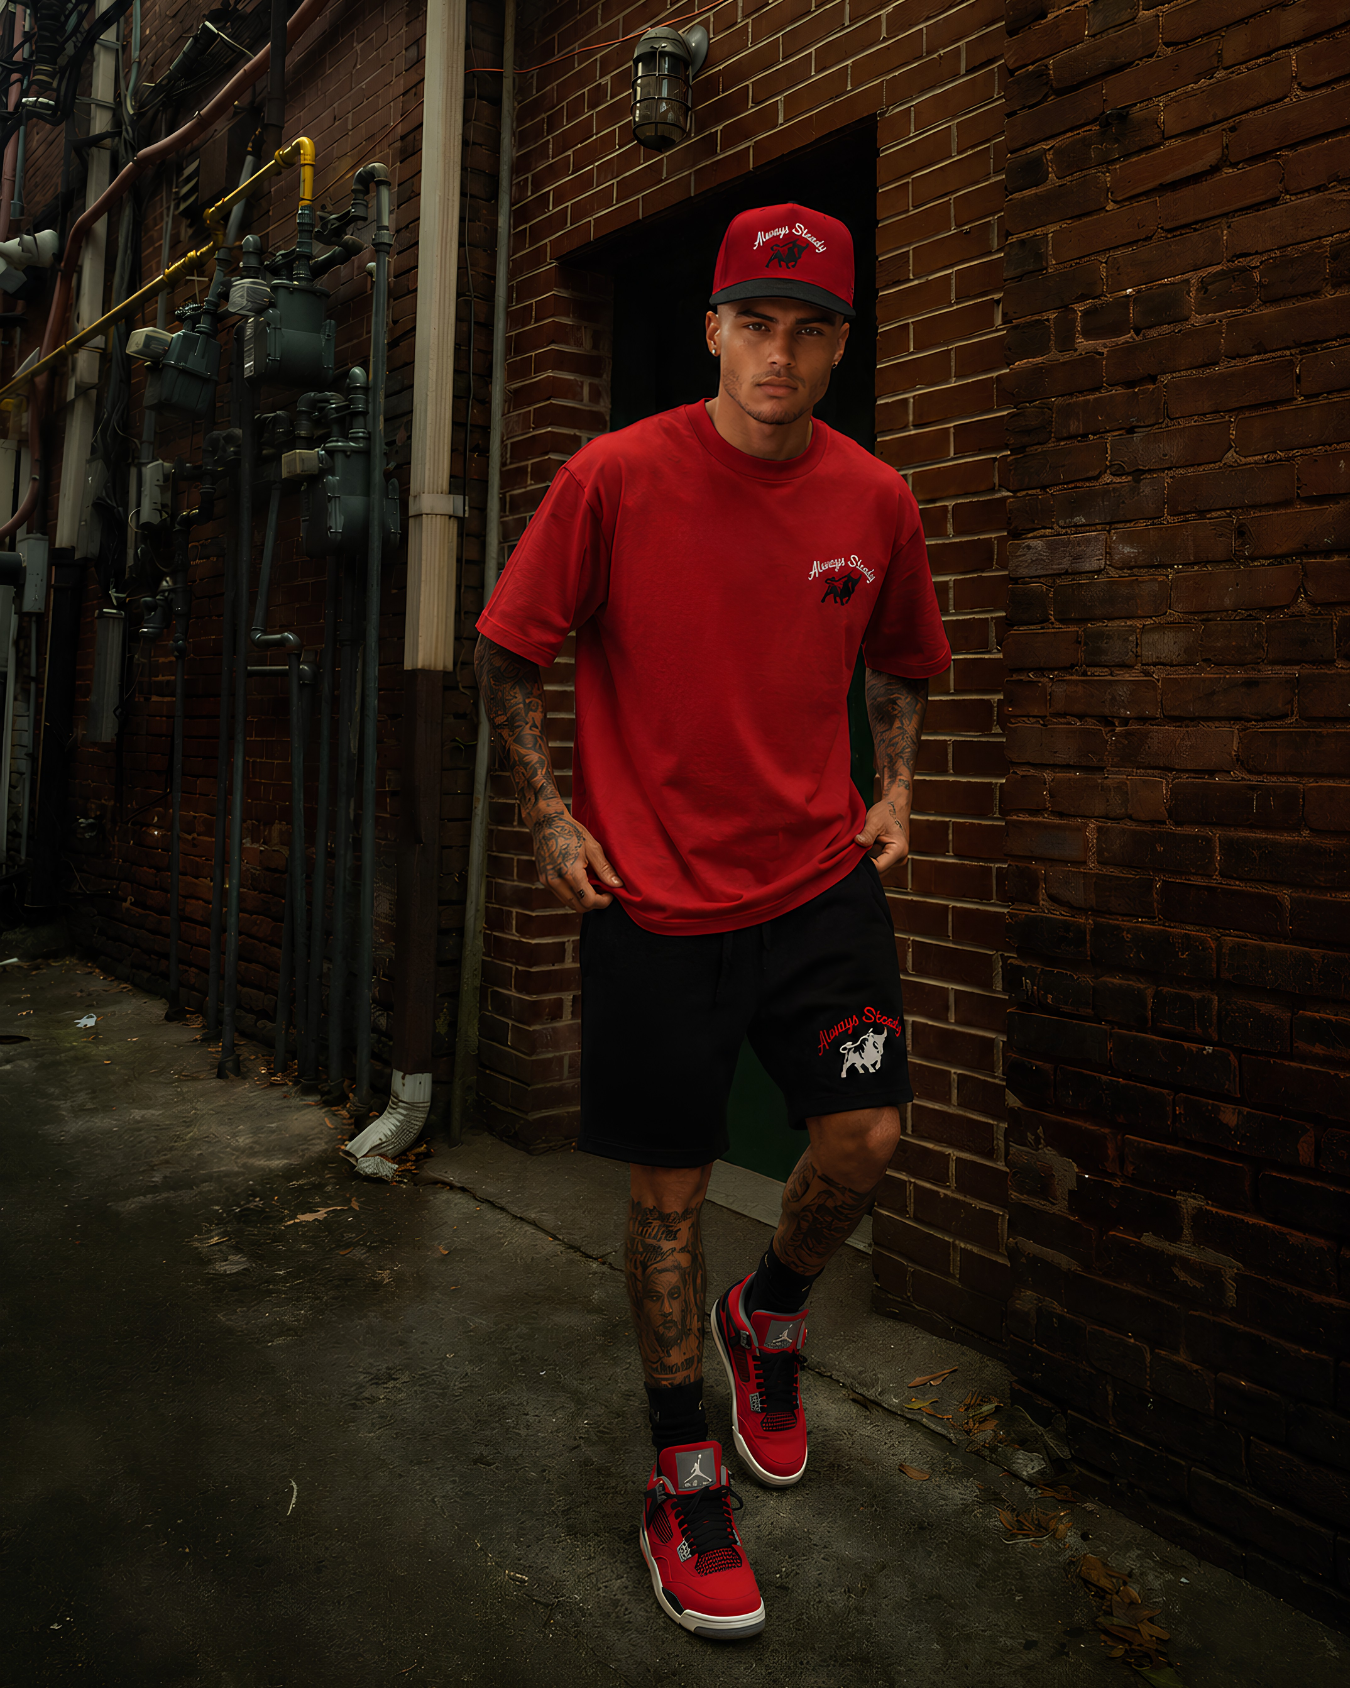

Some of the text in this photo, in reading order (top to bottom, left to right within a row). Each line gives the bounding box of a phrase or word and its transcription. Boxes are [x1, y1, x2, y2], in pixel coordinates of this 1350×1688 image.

[753, 223, 826, 253] Always Steady
[808, 555, 875, 584] Always Steady
[818, 1006, 902, 1056] Always Steady
